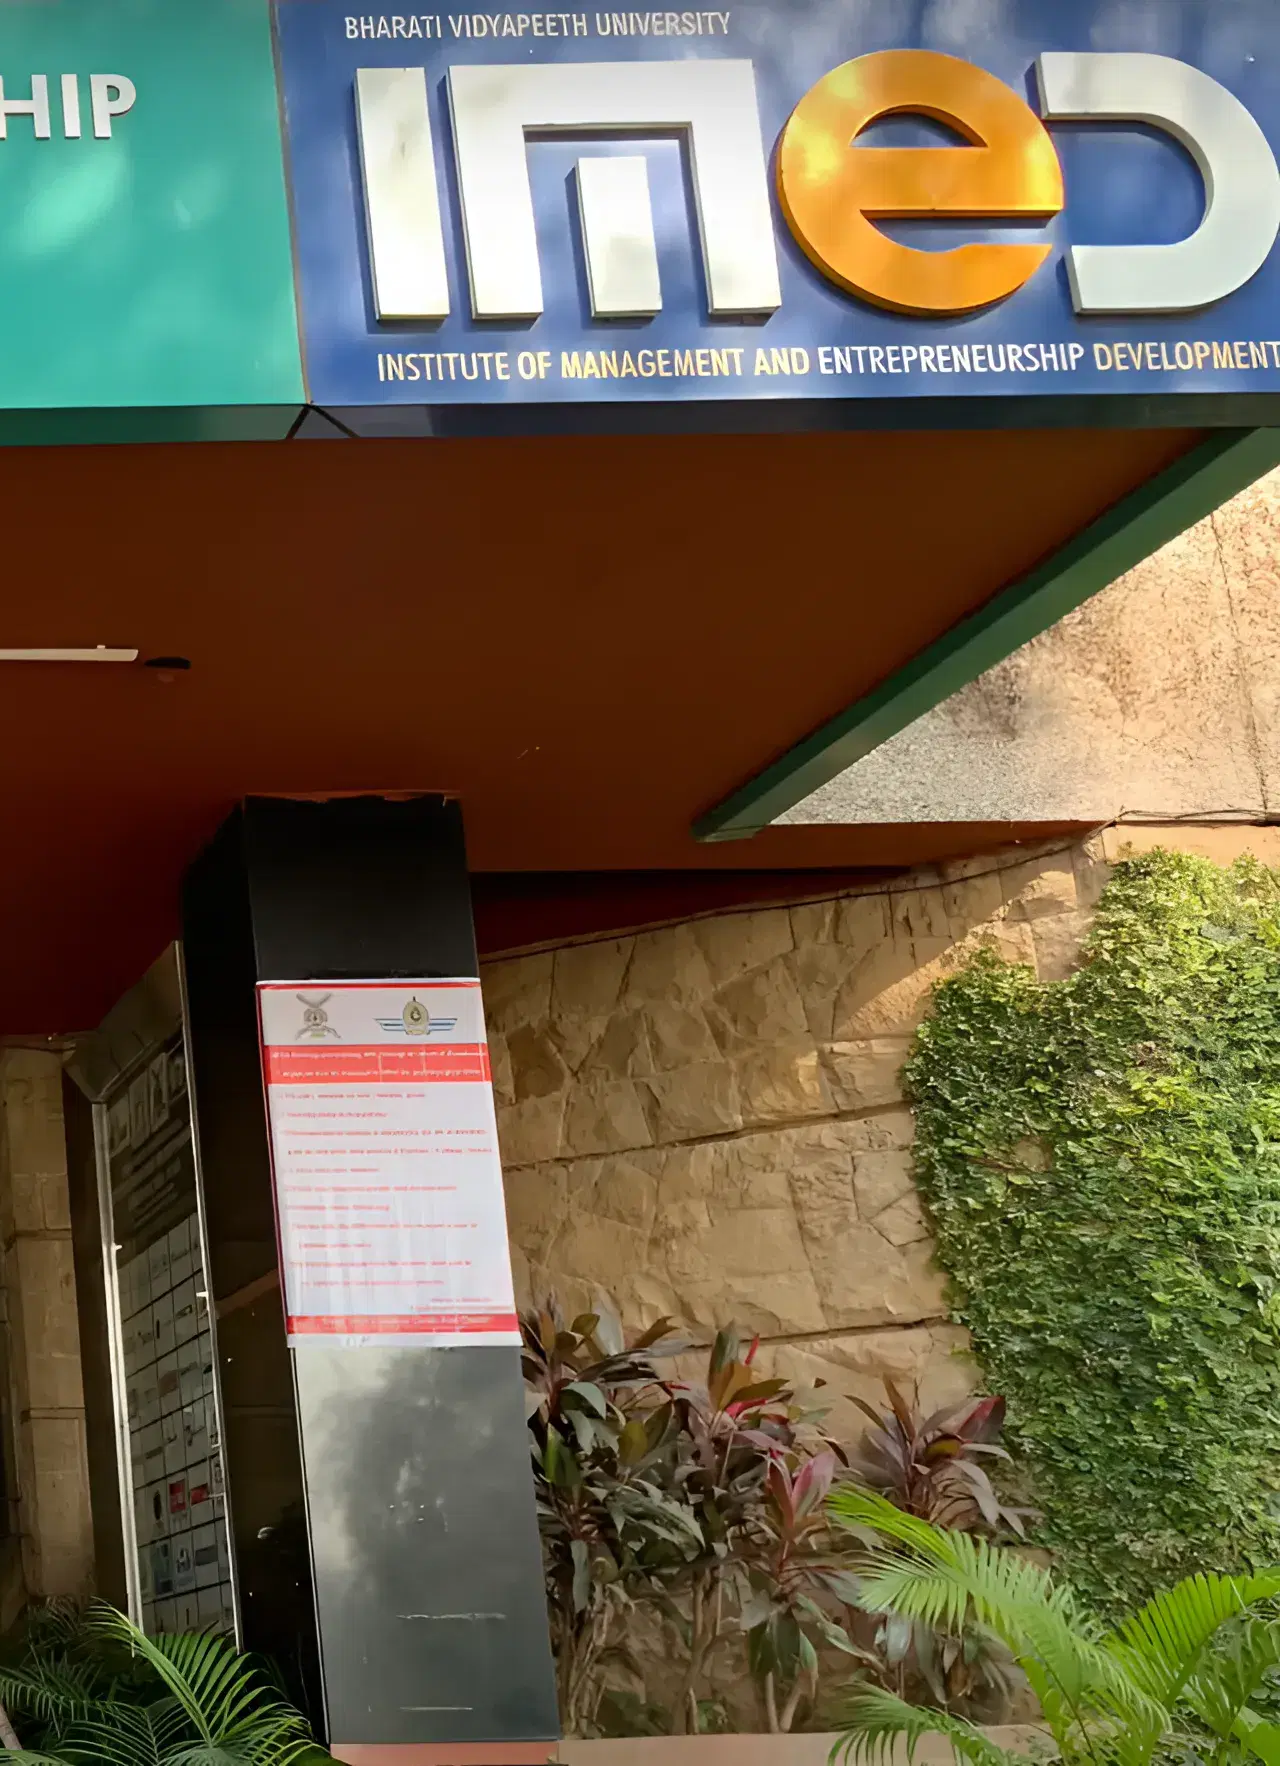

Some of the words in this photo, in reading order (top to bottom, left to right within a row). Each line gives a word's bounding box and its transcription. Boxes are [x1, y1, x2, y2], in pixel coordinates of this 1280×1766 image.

[345, 16, 441, 38] BHARATI
[448, 14, 587, 37] VIDYAPEETH
[596, 12, 730, 36] UNIVERSITY
[377, 352, 512, 382] INSTITUTE
[518, 351, 552, 379] OF
[560, 349, 746, 379] MANAGEMENT
[754, 347, 810, 376] AND
[818, 344, 1085, 374] ENTREPRENEURSHIP
[1093, 340, 1280, 371] DEVELOPMENT
